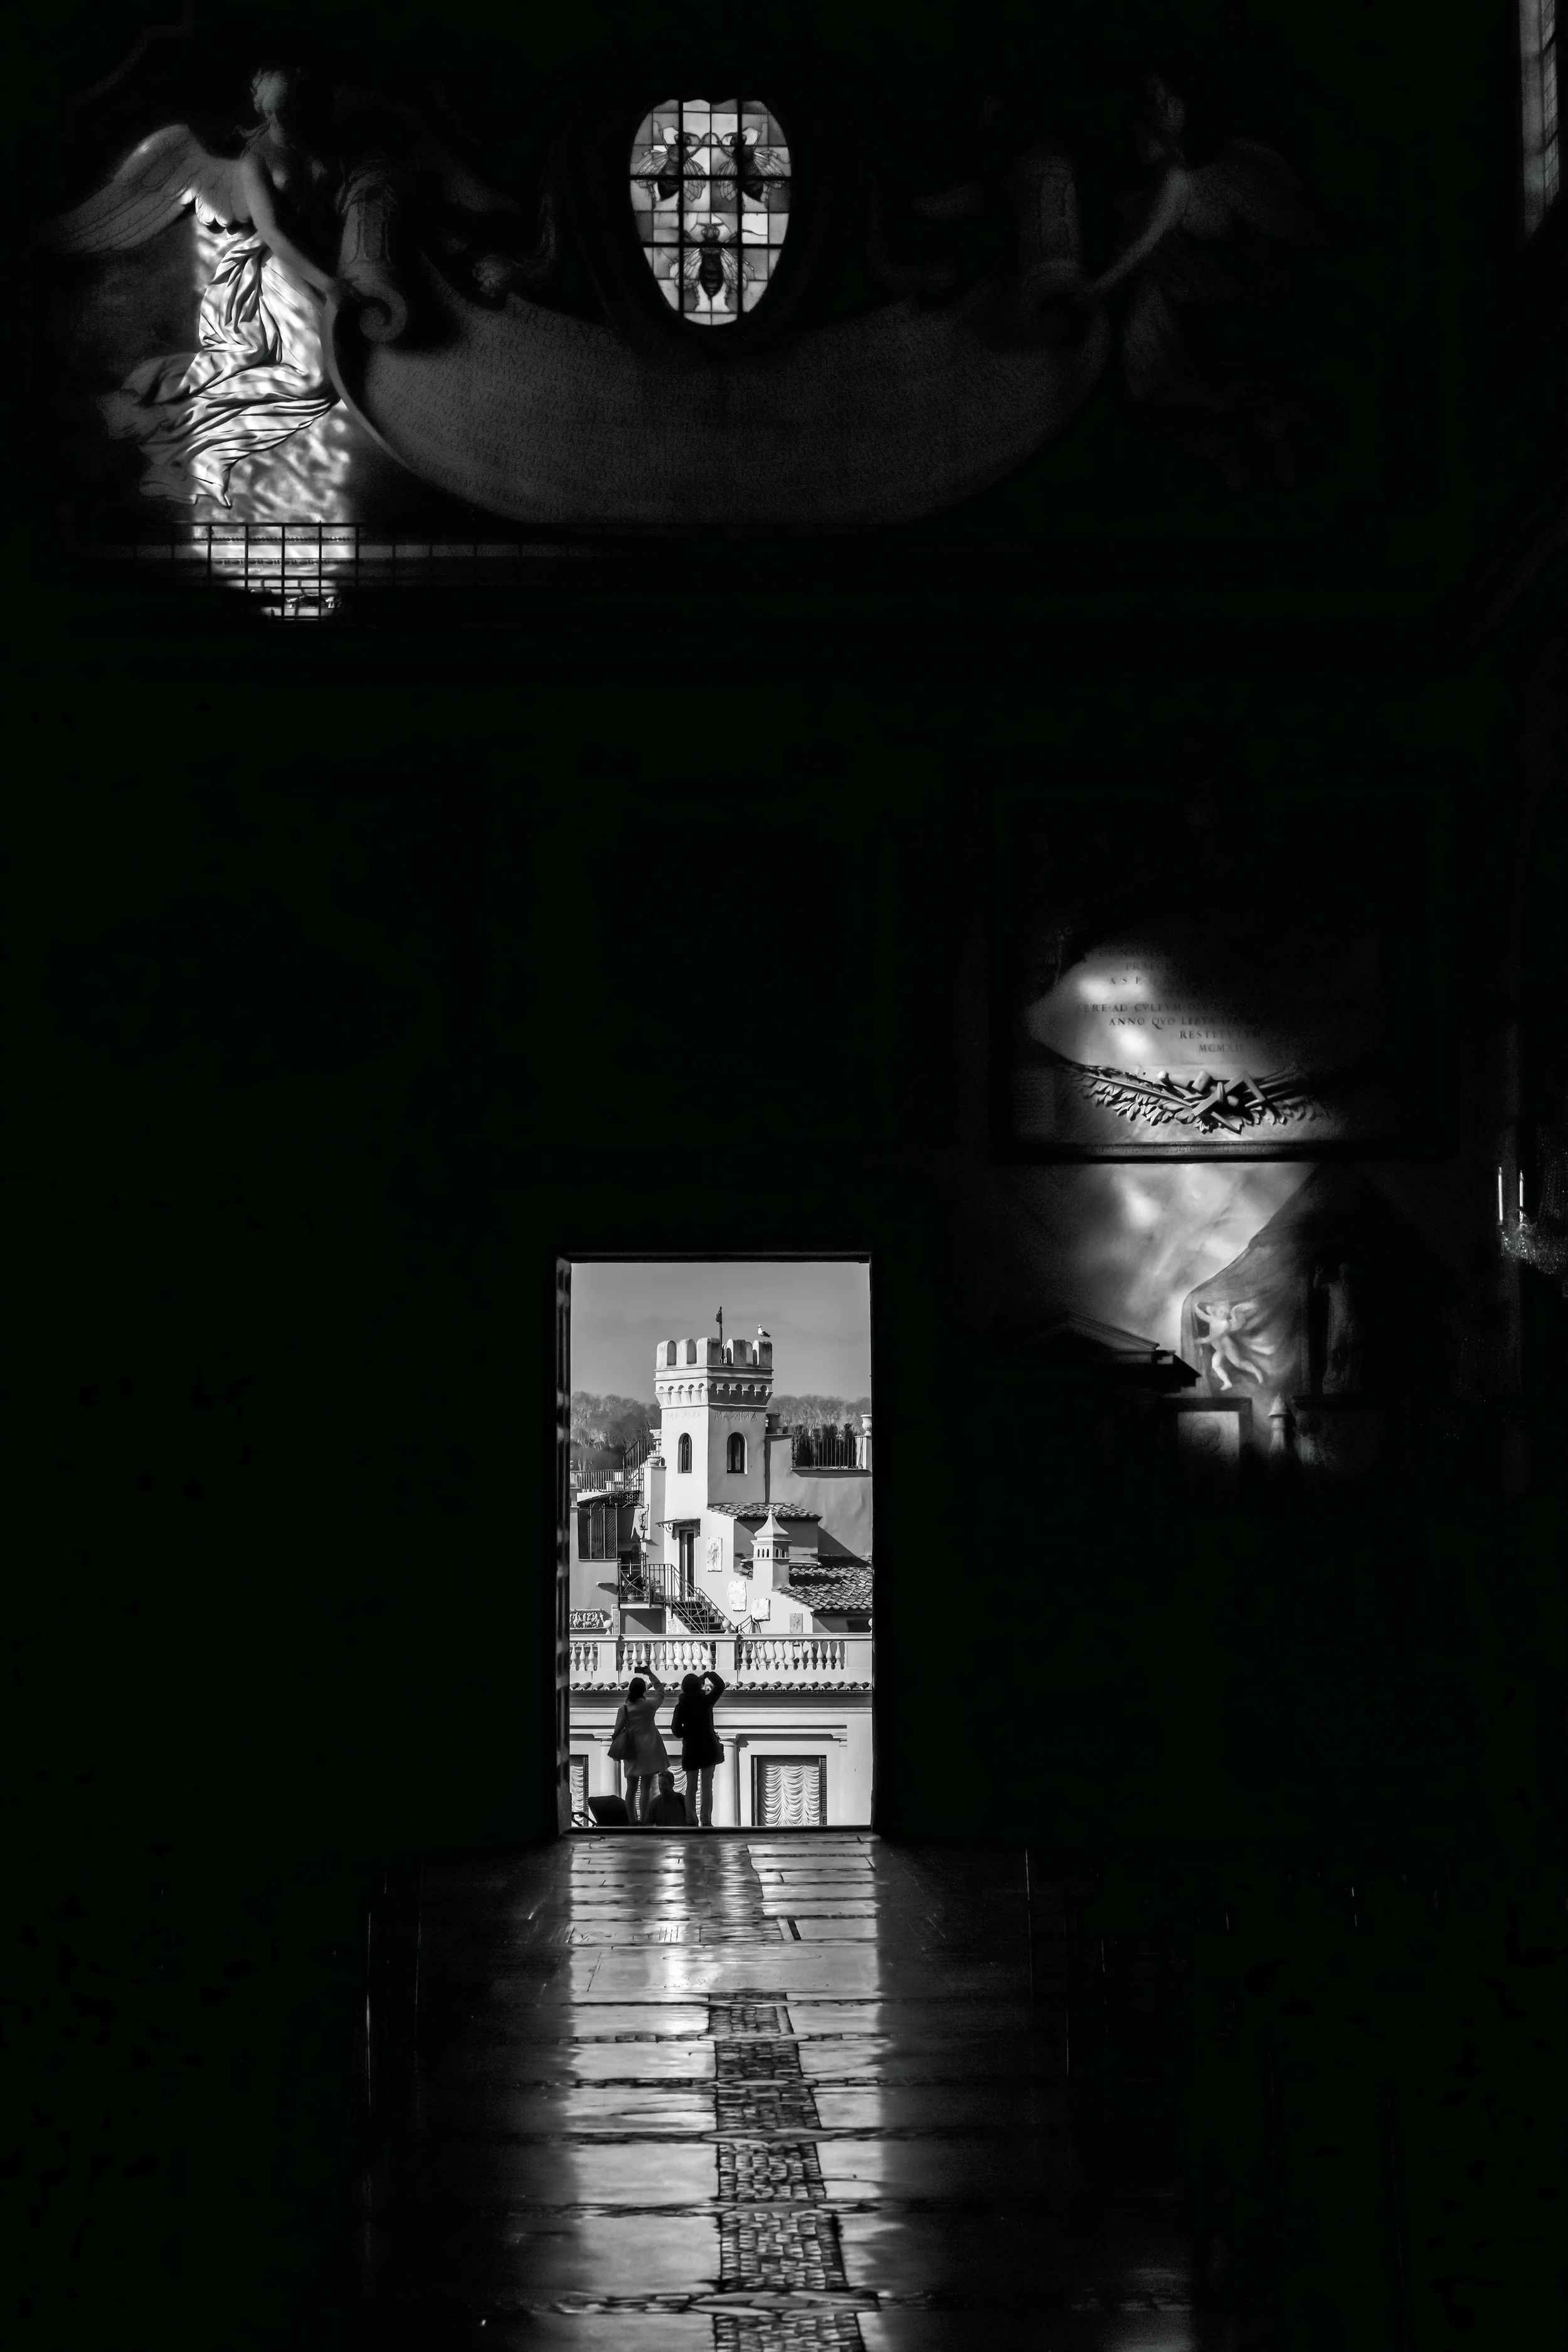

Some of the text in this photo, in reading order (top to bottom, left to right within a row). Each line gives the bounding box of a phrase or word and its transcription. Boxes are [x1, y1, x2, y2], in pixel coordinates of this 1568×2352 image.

[1113, 1004, 1128, 1012] AD
[1109, 1017, 1145, 1026] ANNO
[1151, 1017, 1175, 1029] QVO
[714, 1411, 758, 1422] MAXIMA
